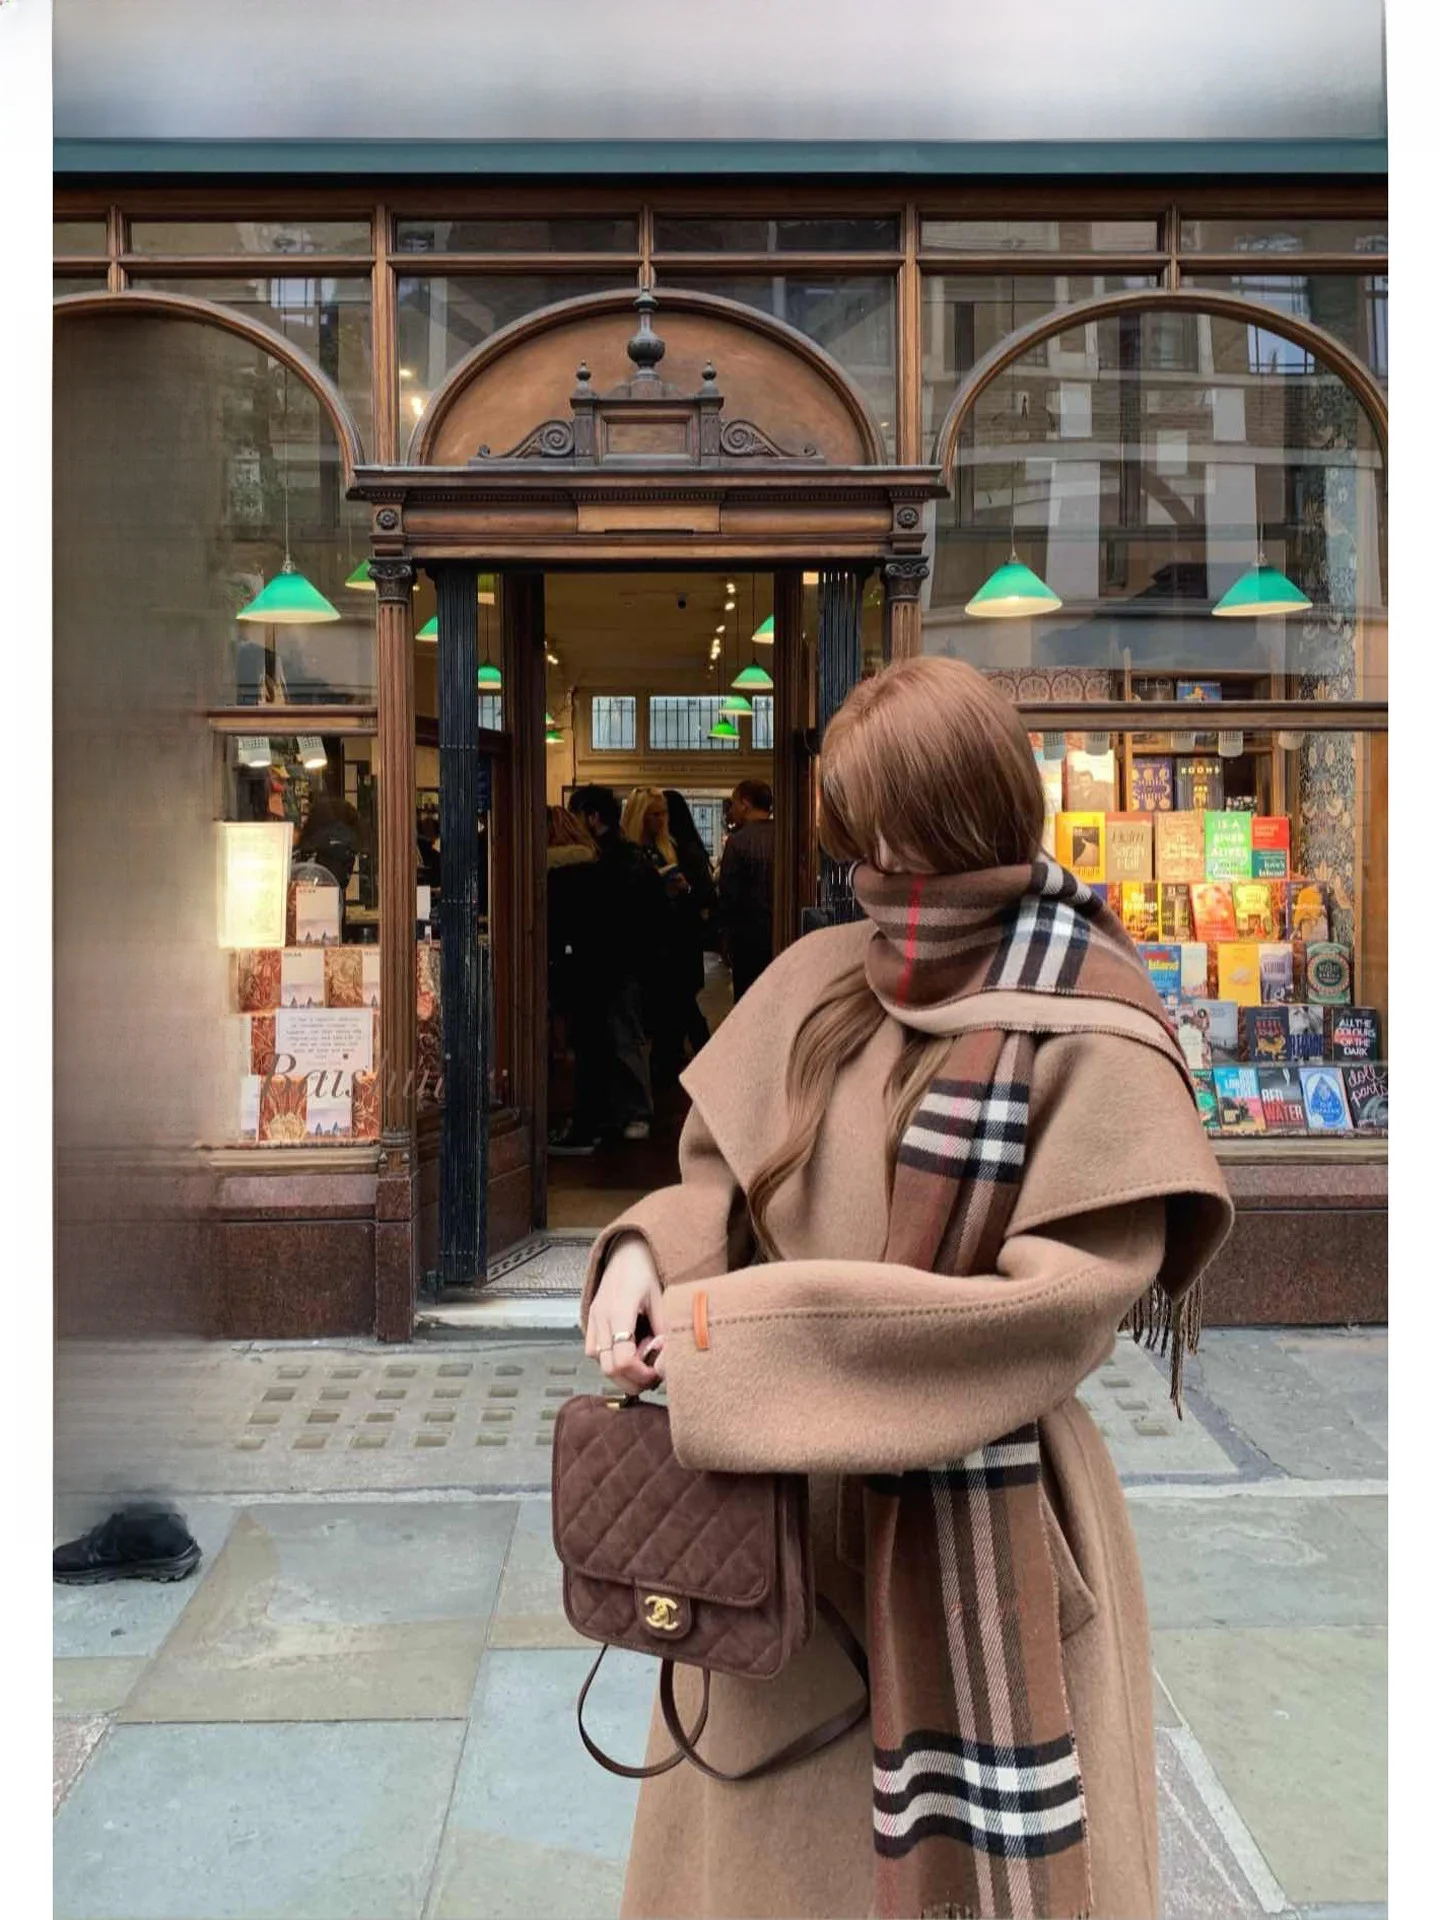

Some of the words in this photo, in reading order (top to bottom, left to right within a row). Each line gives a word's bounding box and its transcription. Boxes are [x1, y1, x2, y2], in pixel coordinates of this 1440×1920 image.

[1339, 1018, 1354, 1028] ALL
[1343, 1046, 1368, 1056] DARK
[1261, 1088, 1284, 1104] RED
[1263, 1101, 1304, 1121] WATER
